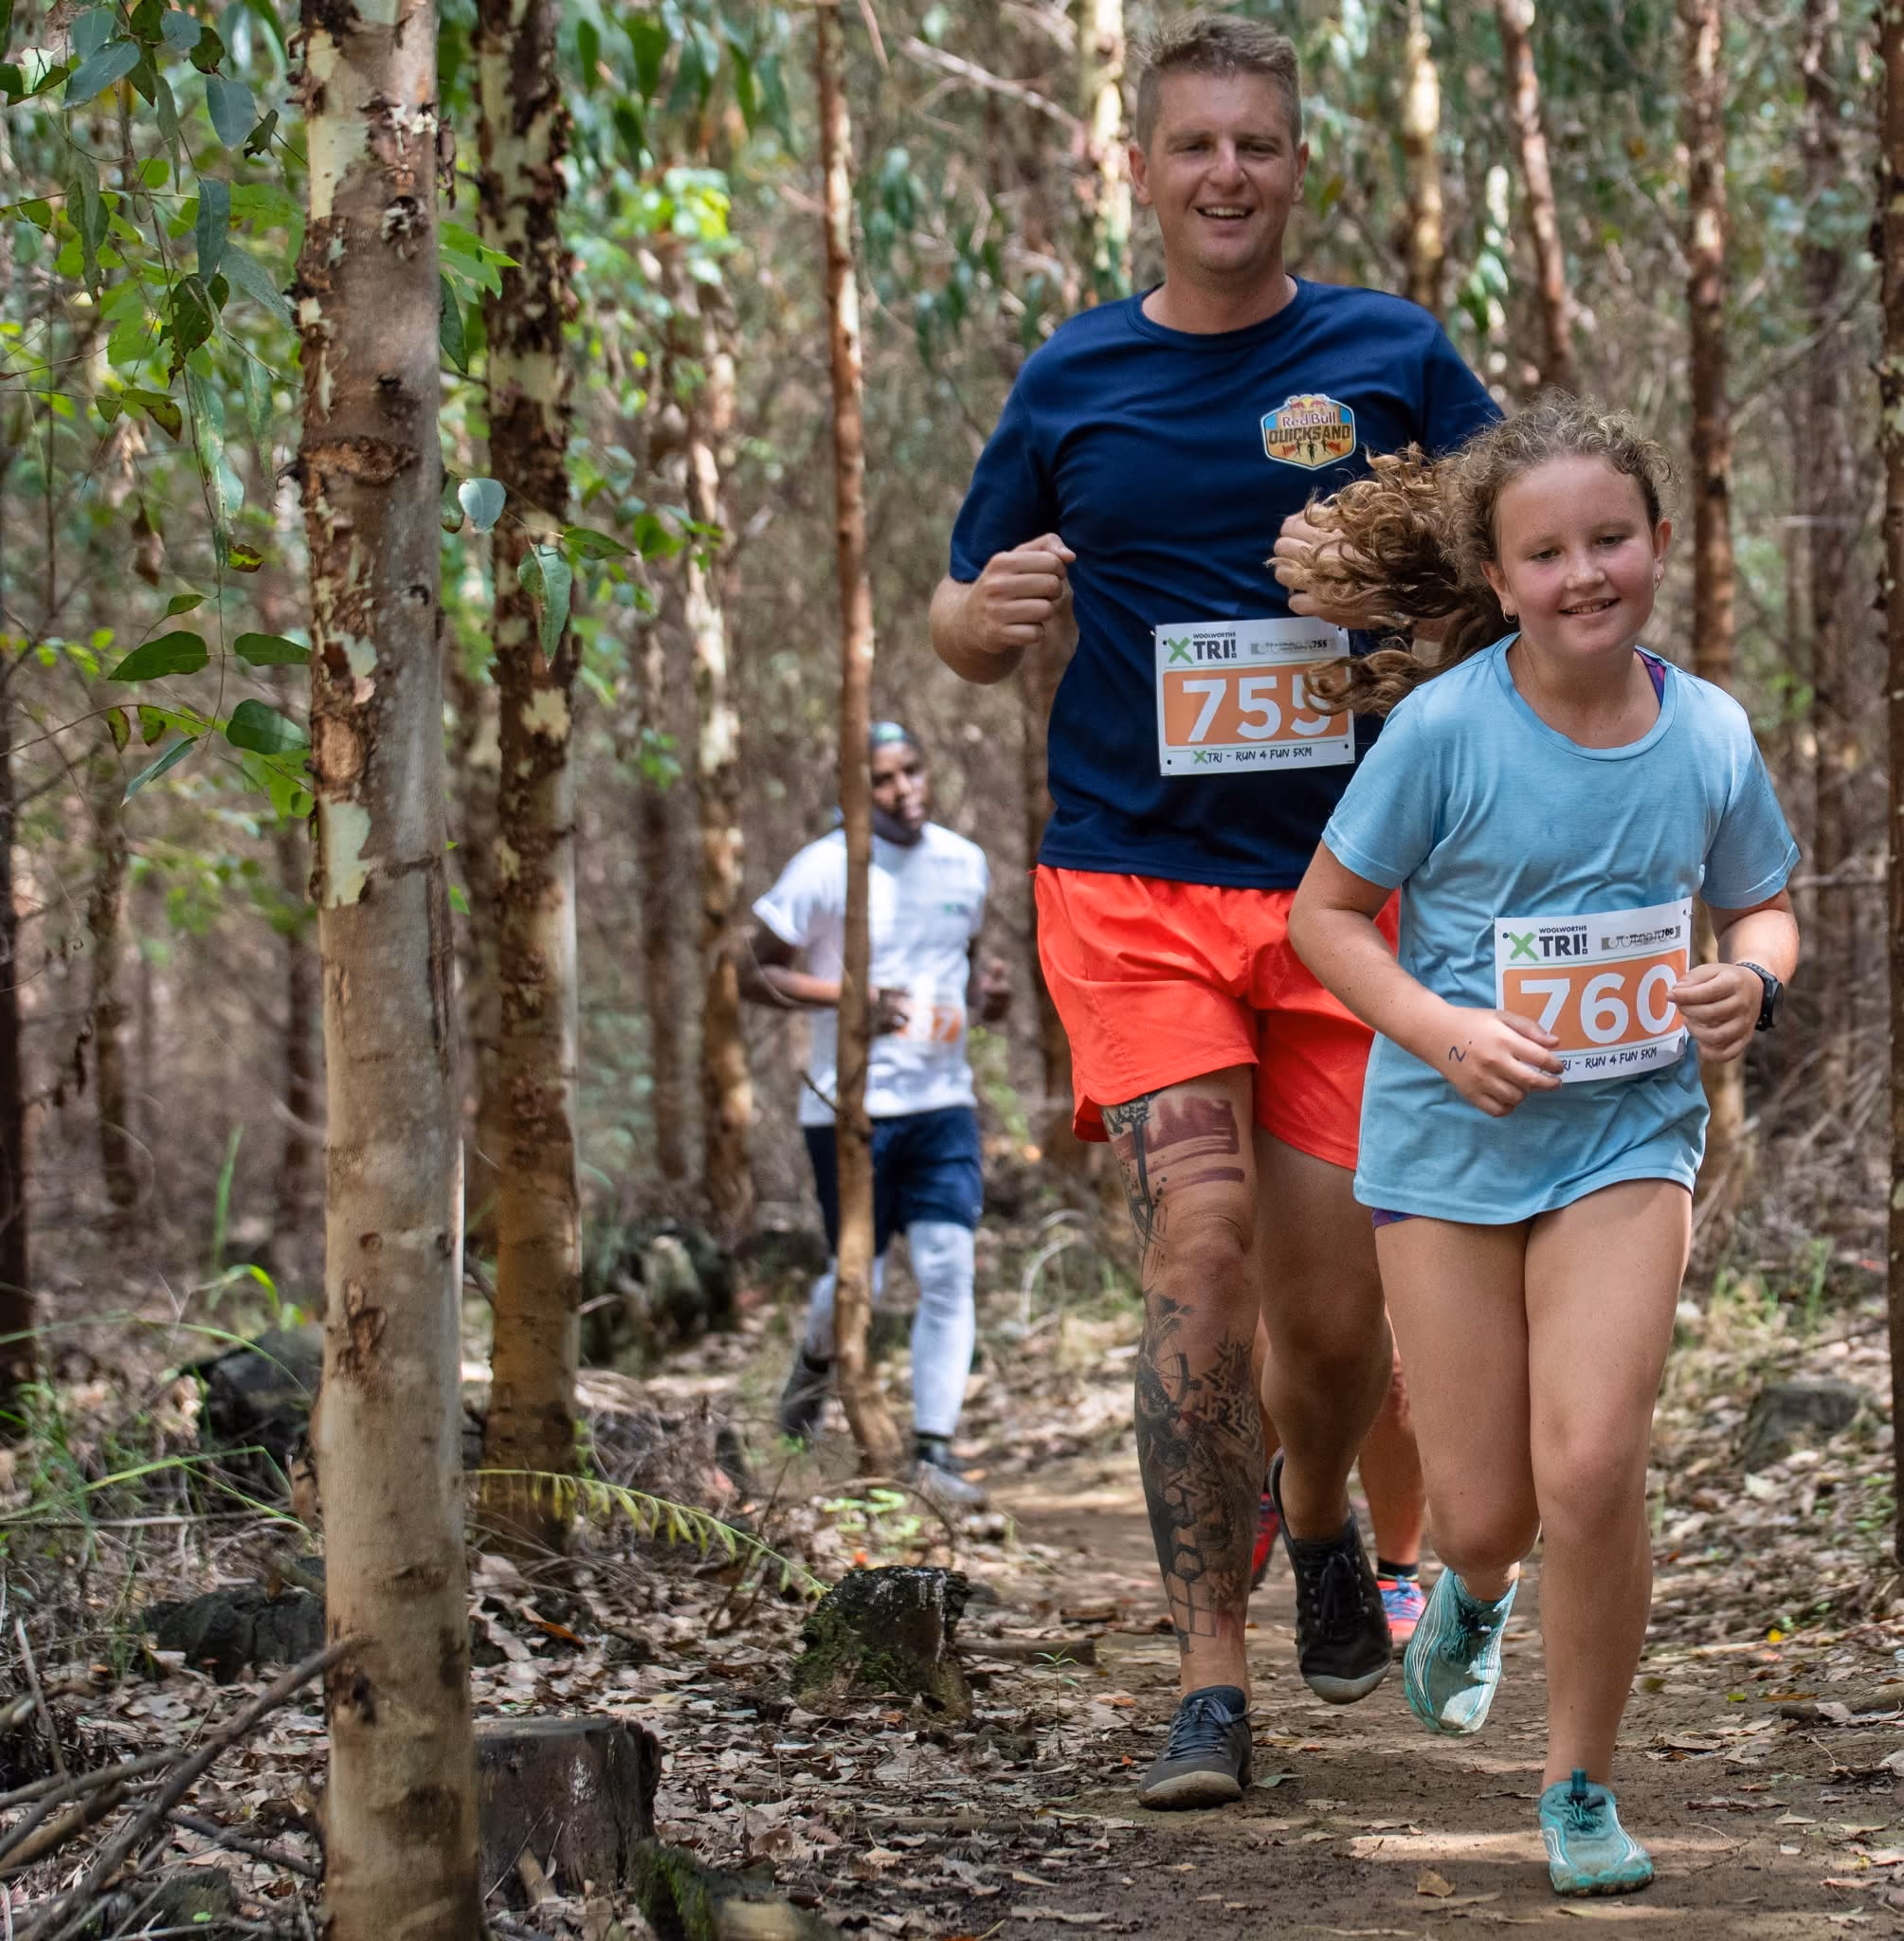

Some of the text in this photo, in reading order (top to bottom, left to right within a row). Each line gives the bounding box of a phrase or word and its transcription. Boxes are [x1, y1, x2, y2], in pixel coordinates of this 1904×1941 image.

[1282, 411, 1335, 426] Red Bull
[1268, 425, 1351, 444] QUICKSAND
[1192, 631, 1237, 640] WOOLWORTHS
[1312, 639, 1328, 649] 755
[1182, 674, 1332, 743] 755
[1235, 751, 1256, 761] RUN
[1260, 751, 1267, 759] 4
[1270, 749, 1290, 759] FUN
[1293, 747, 1312, 757] 5KM
[1538, 925, 1587, 934] WOOLWORTHS
[1520, 963, 1677, 1044] 760
[1585, 1055, 1606, 1069] RUN
[1609, 1054, 1617, 1064] 4
[1620, 1050, 1639, 1063] FUN
[1641, 1046, 1657, 1060] 5KM
